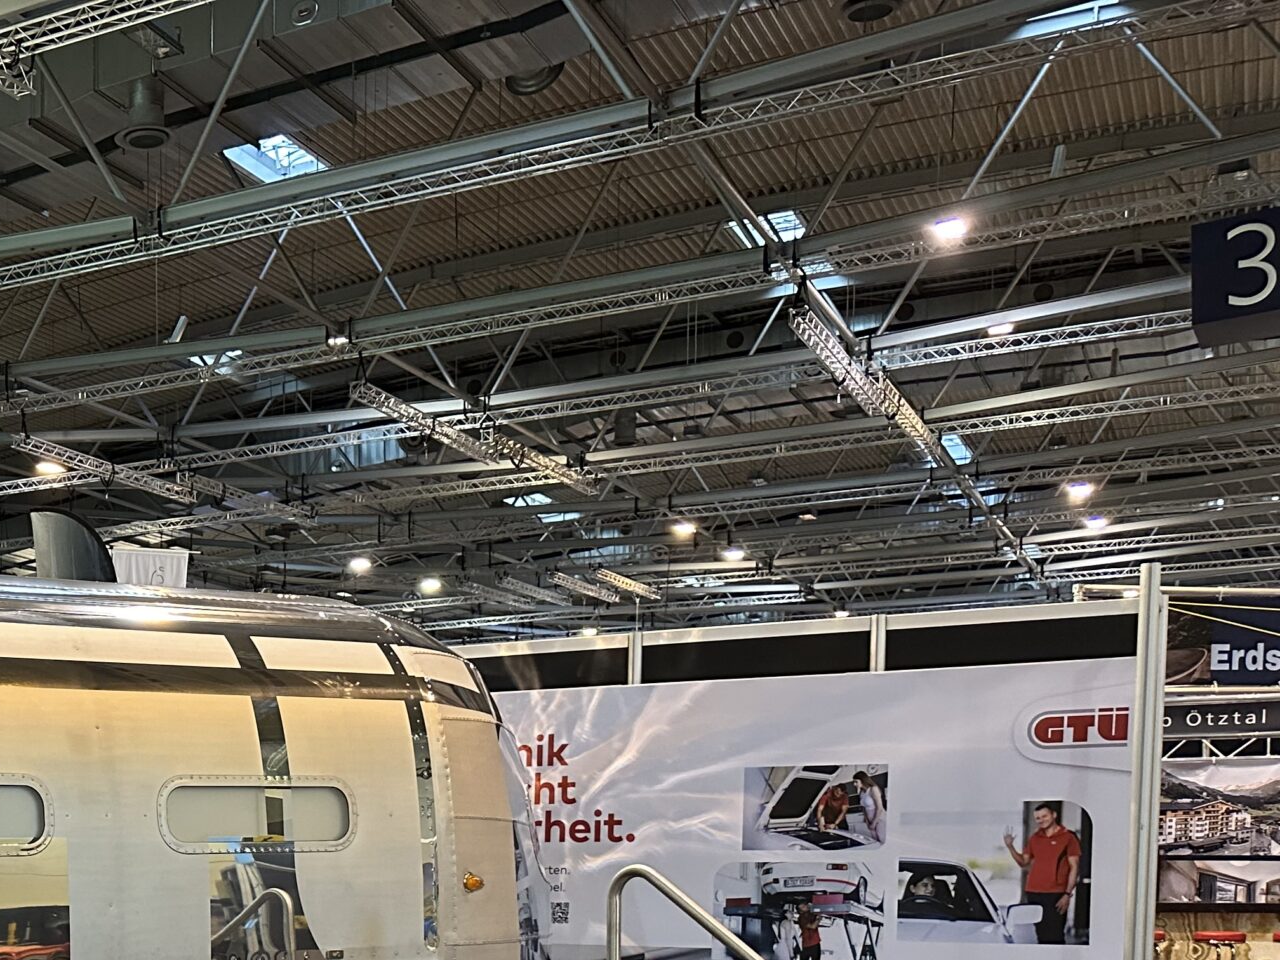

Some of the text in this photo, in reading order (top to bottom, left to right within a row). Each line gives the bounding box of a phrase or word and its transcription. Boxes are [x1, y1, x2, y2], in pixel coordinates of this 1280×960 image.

[1227, 222, 1277, 306] 3
[1210, 642, 1280, 671] Erds
[1033, 706, 1130, 744] GTÜ
[1186, 709, 1267, 727] Ötztal
[527, 772, 578, 805] ht
